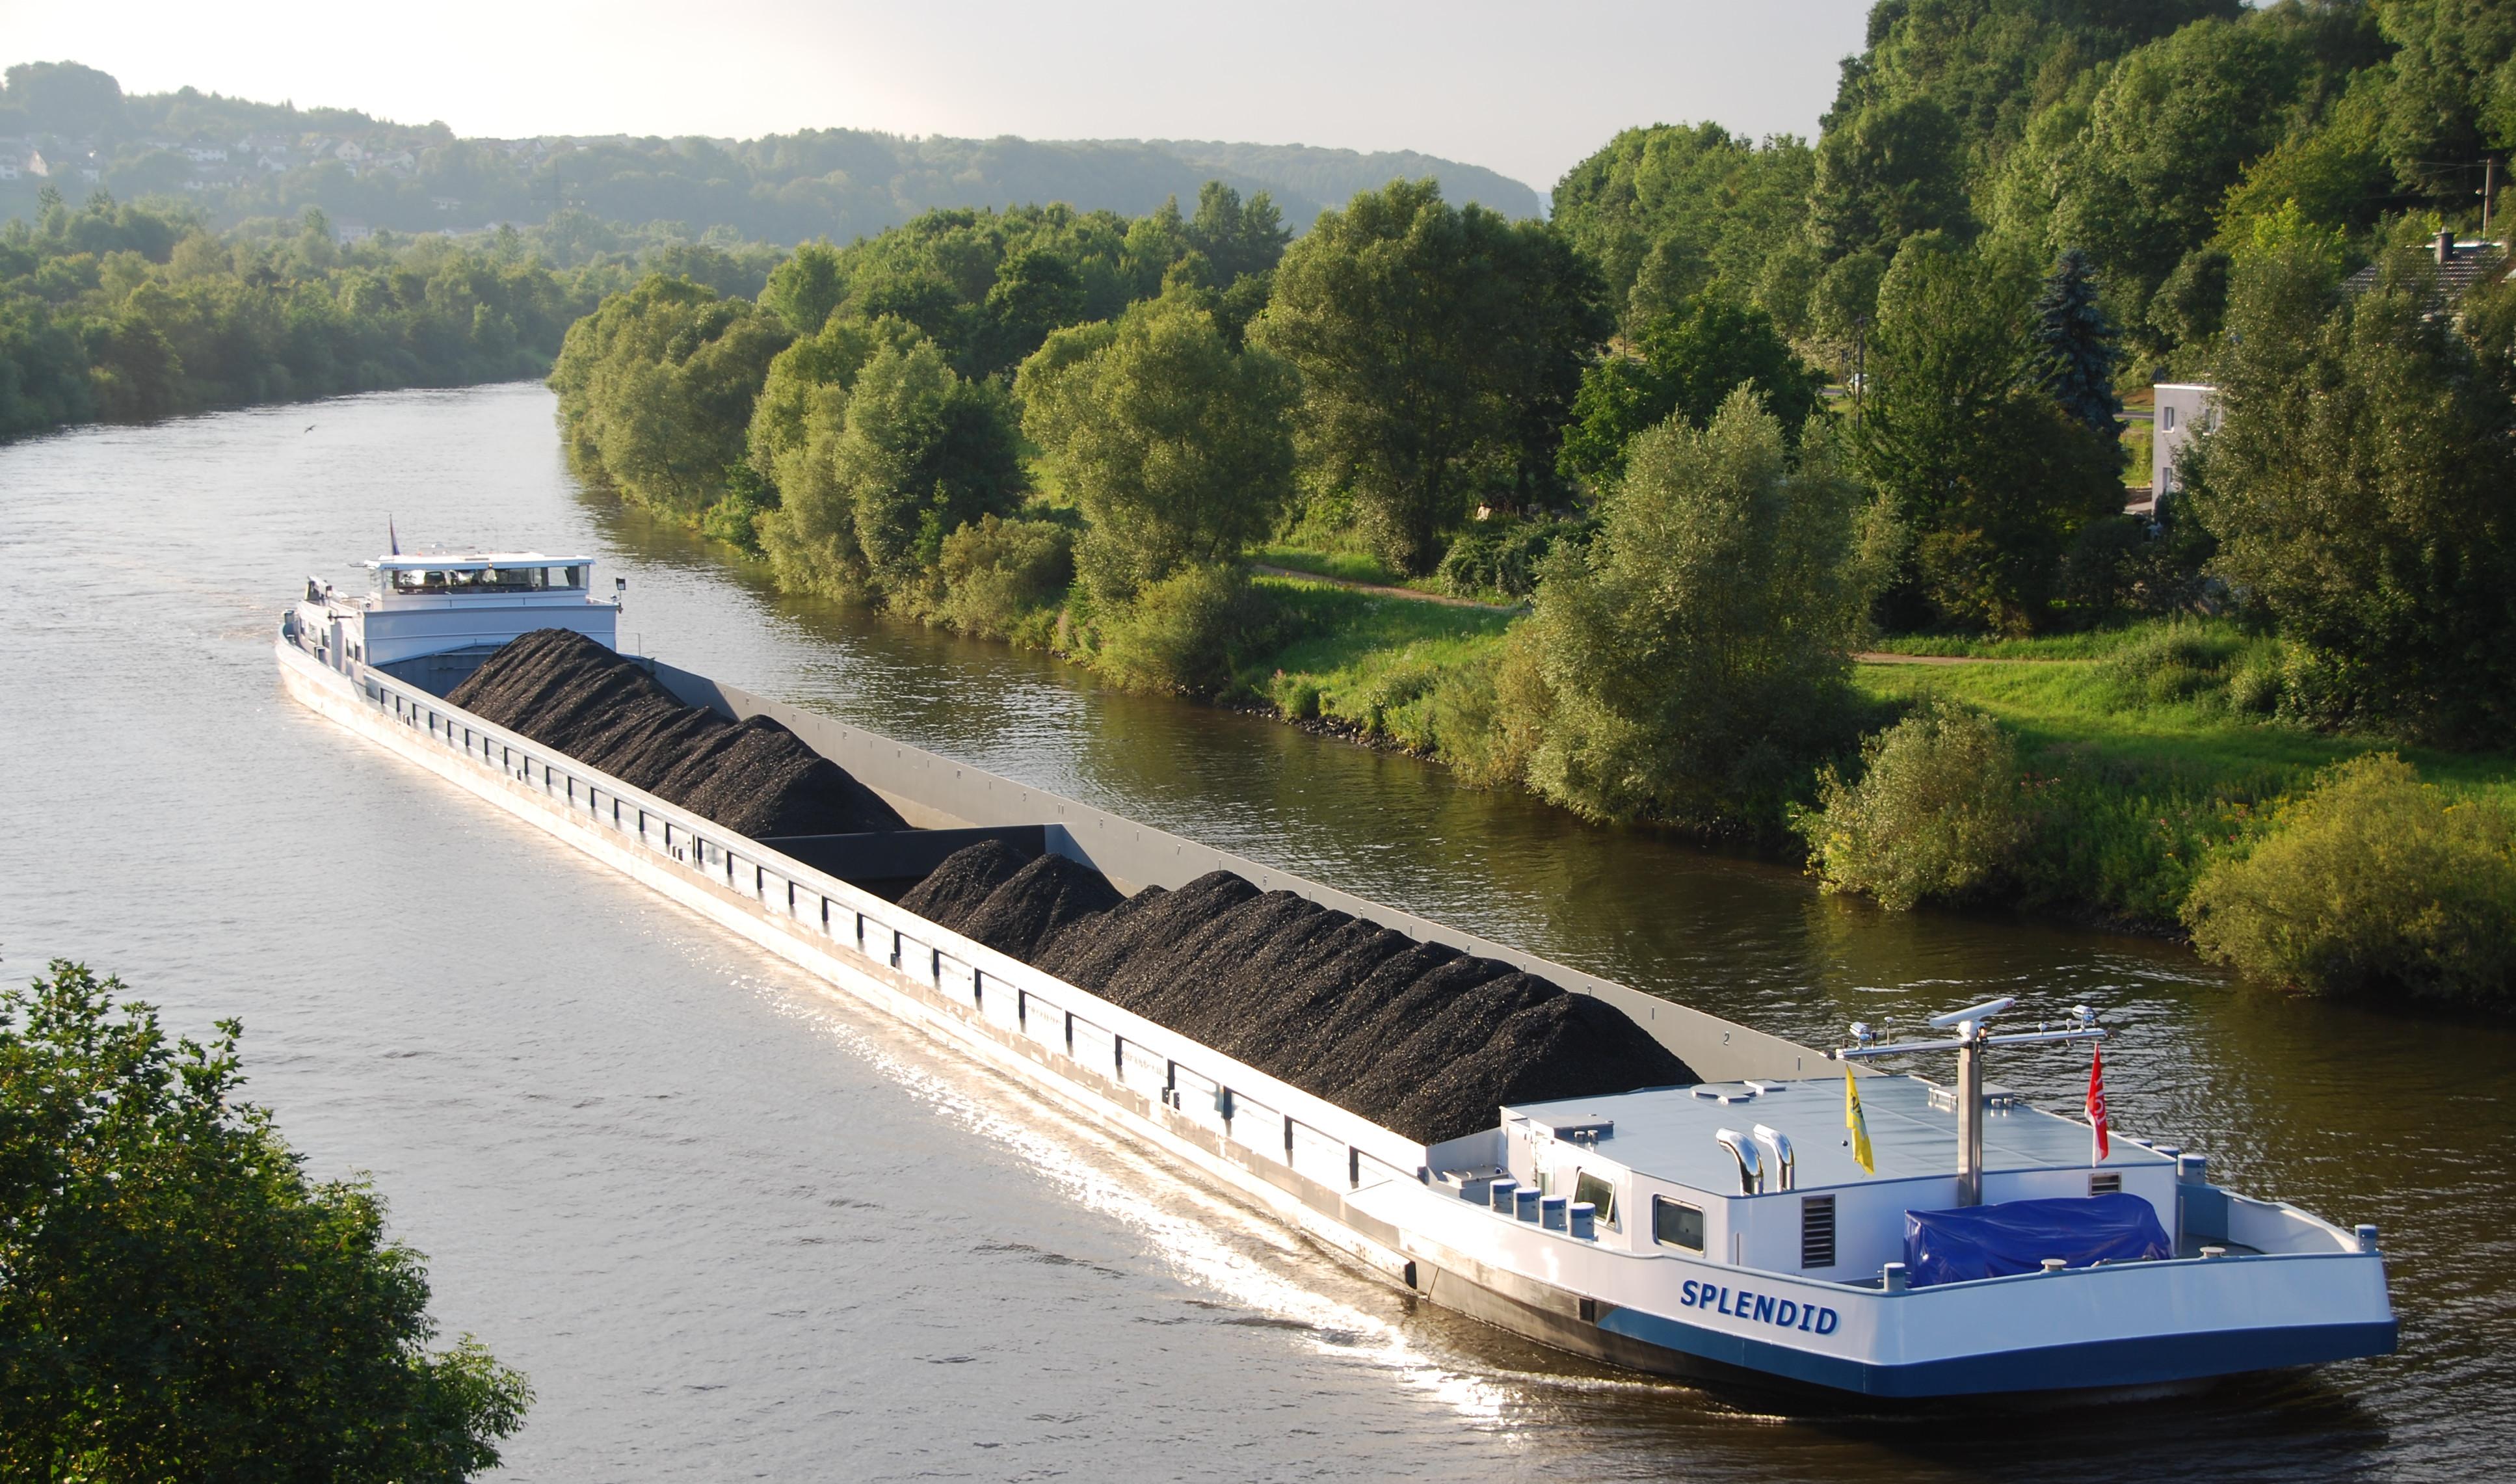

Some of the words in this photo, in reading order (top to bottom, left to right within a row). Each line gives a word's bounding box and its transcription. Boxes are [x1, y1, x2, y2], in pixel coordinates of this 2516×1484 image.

[1176, 844, 1182, 855] 7
[1723, 1031, 1730, 1046] 2
[1680, 1280, 1839, 1335] SPLENDID
